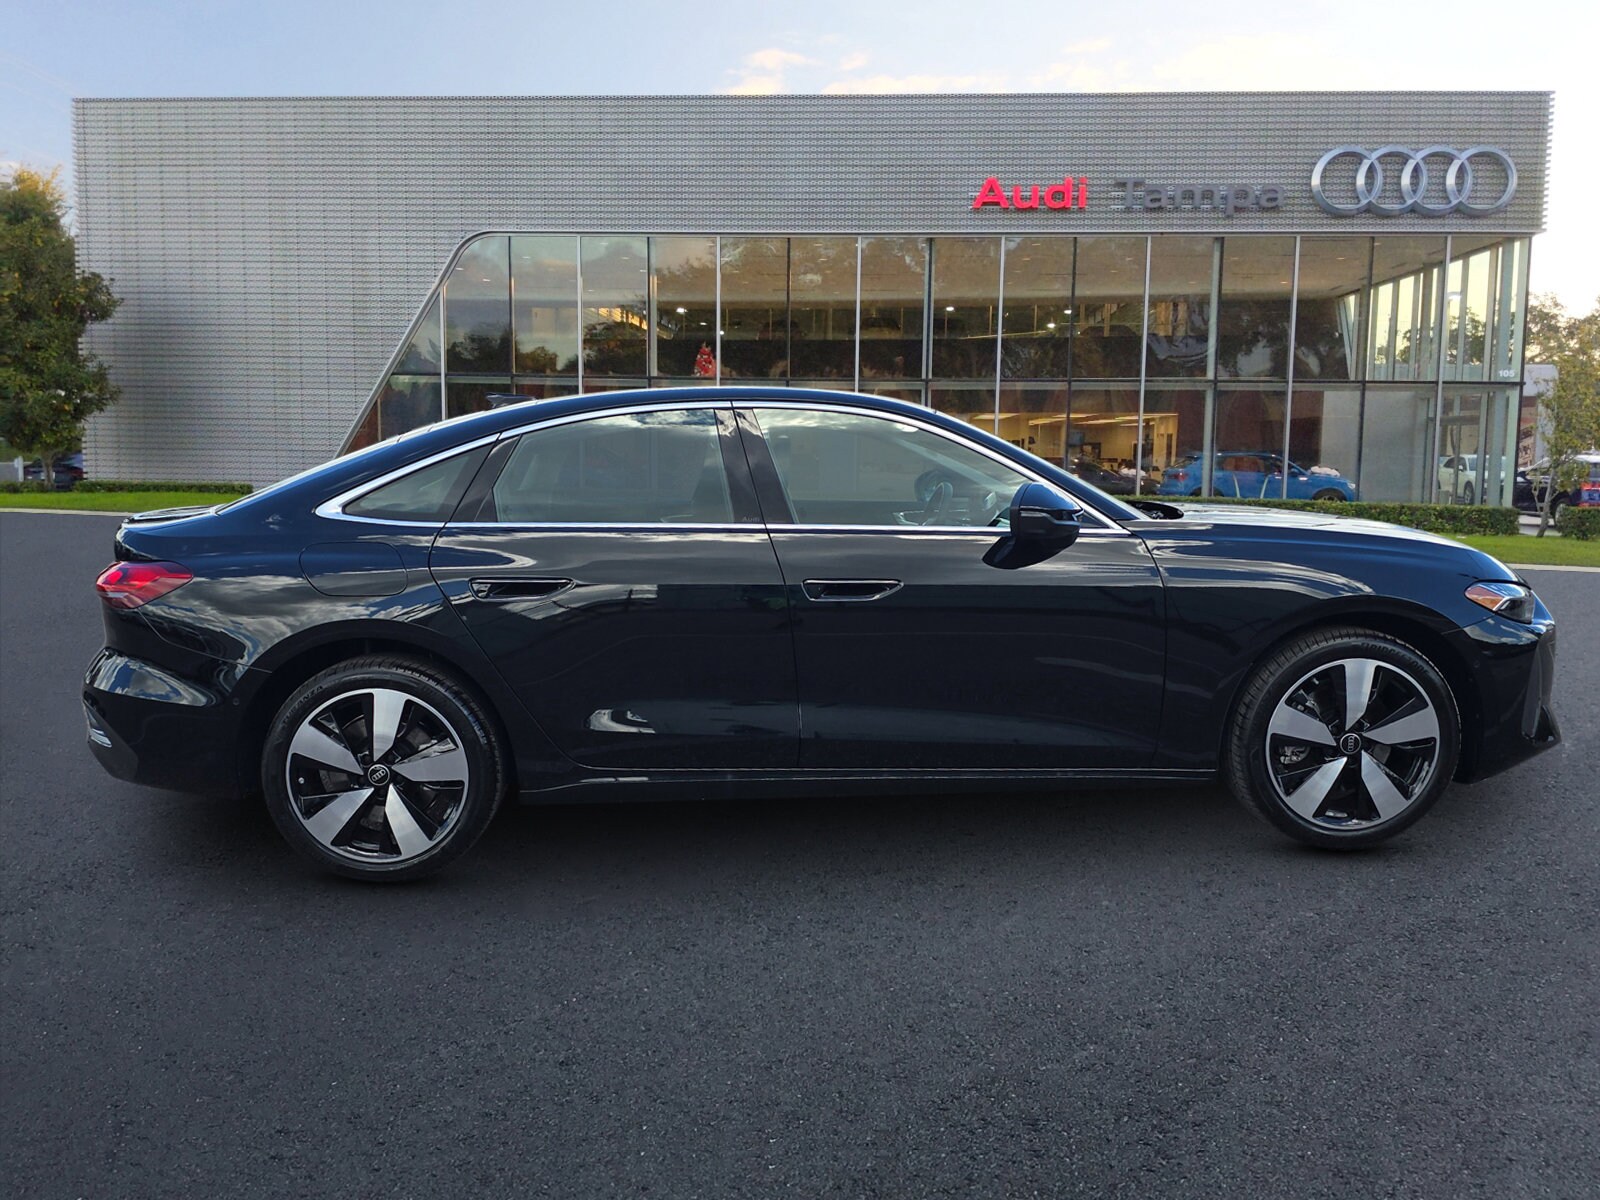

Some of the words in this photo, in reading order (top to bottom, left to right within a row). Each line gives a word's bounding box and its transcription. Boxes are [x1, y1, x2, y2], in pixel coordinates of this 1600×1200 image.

[972, 177, 1088, 209] Audi
[1115, 177, 1285, 218] Tampa
[1498, 369, 1516, 378] 105
[1361, 641, 1430, 674] BRIDGEONE
